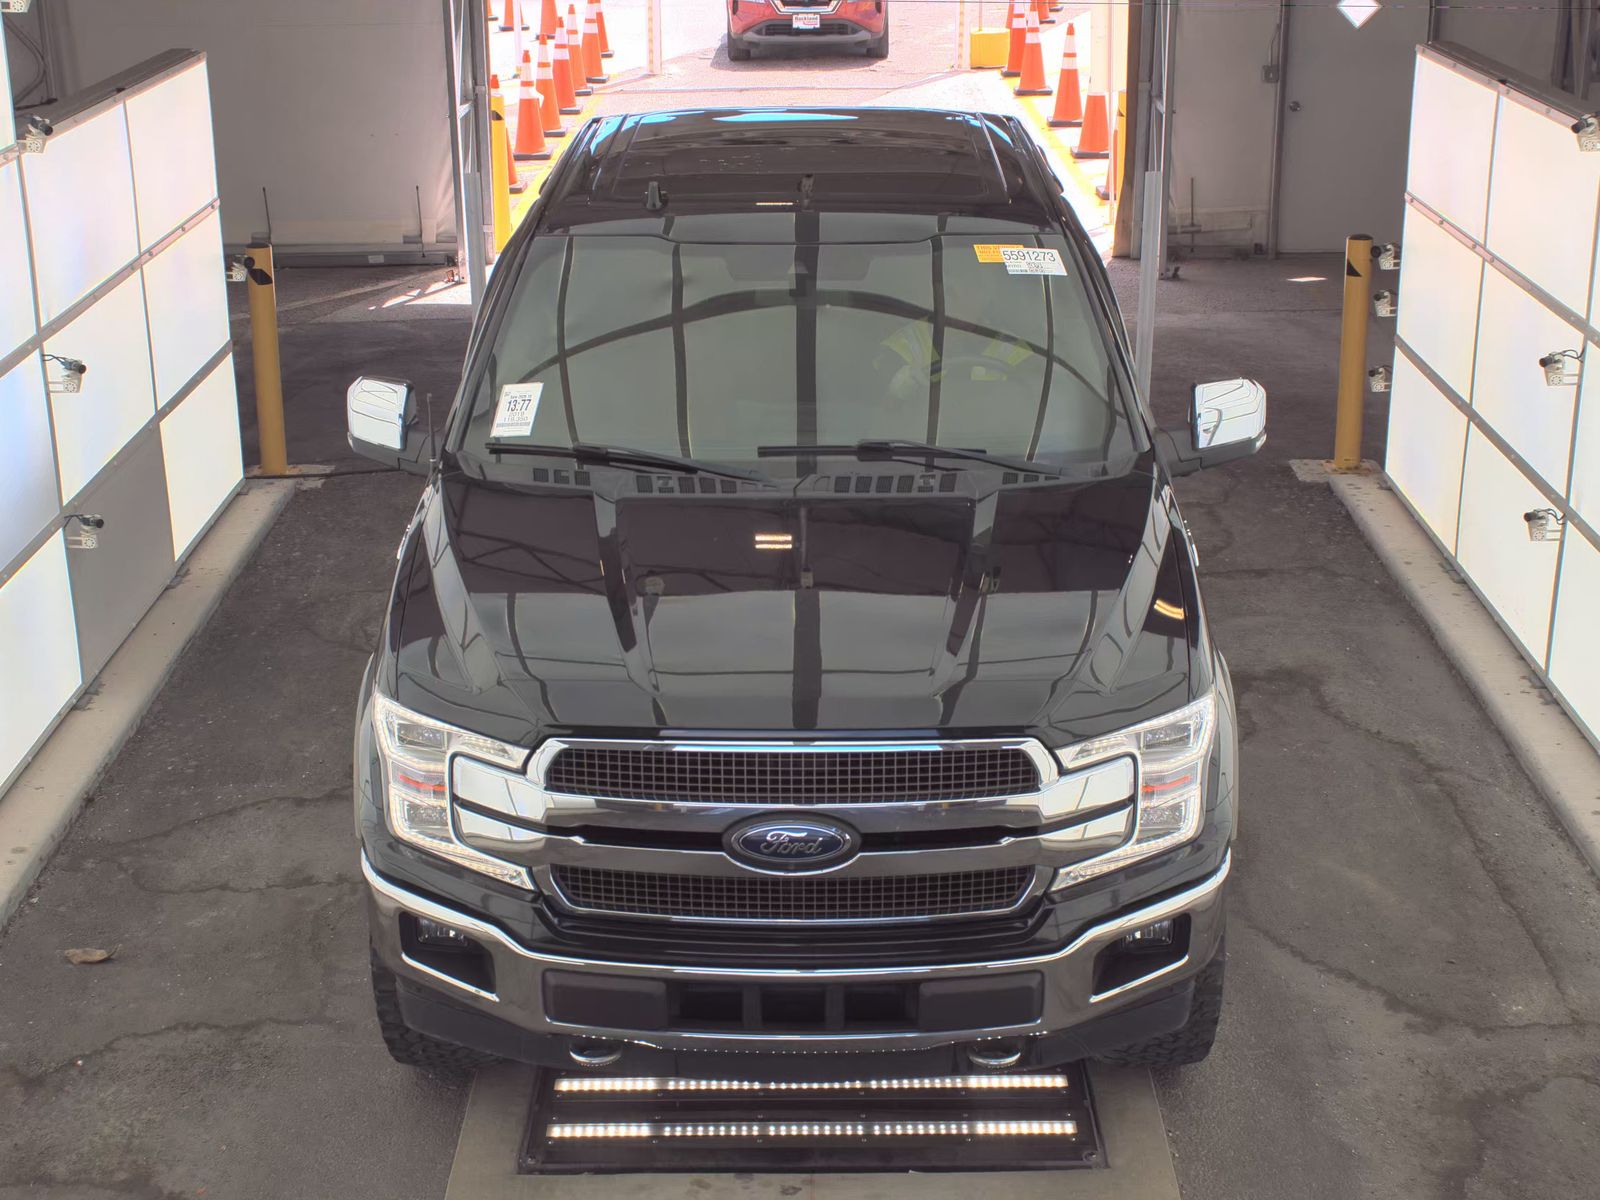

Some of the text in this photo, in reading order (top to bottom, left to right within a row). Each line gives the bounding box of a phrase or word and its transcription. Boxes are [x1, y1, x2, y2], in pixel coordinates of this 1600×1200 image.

[1002, 250, 1056, 262] 5591273
[507, 398, 532, 412] 13:77
[760, 831, 824, 855] Ford
